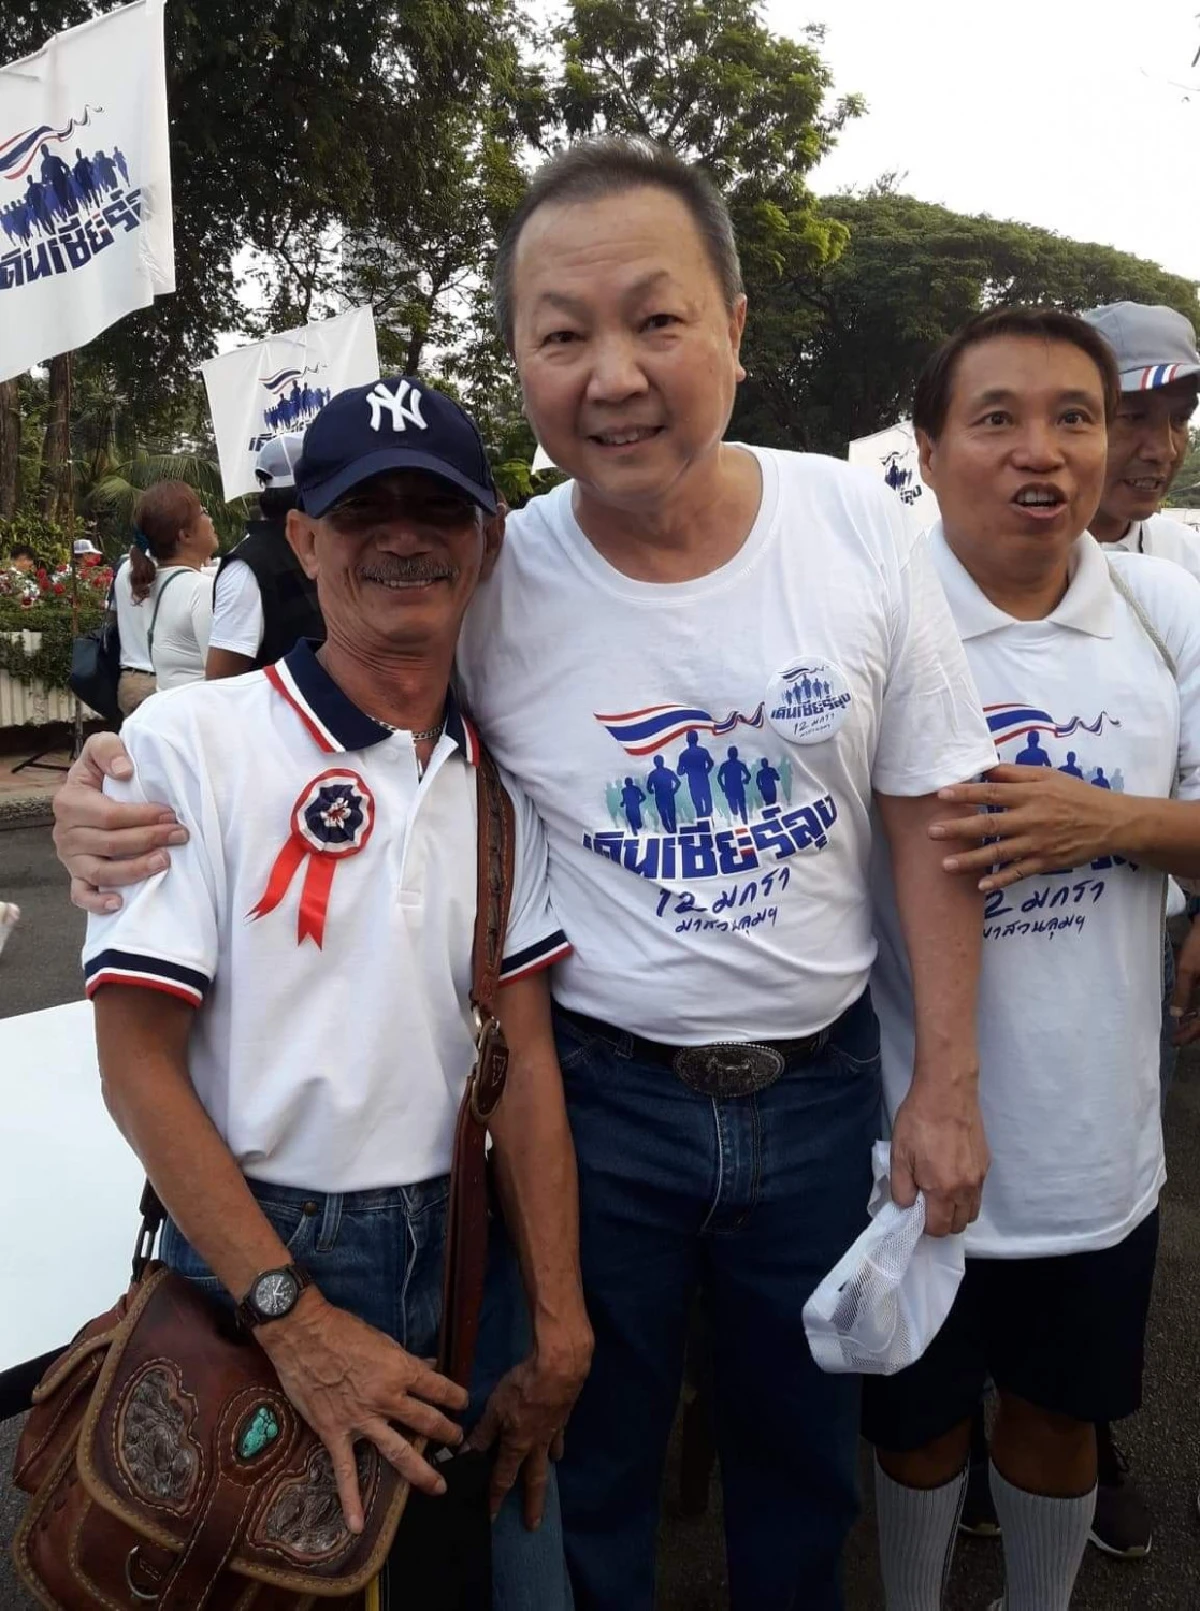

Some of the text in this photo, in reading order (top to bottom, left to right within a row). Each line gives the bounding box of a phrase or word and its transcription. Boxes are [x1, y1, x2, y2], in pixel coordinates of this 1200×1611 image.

[366, 379, 429, 432] NY
[656, 866, 791, 917] 12 มกรา
[984, 879, 1105, 919] 2 มกรา
